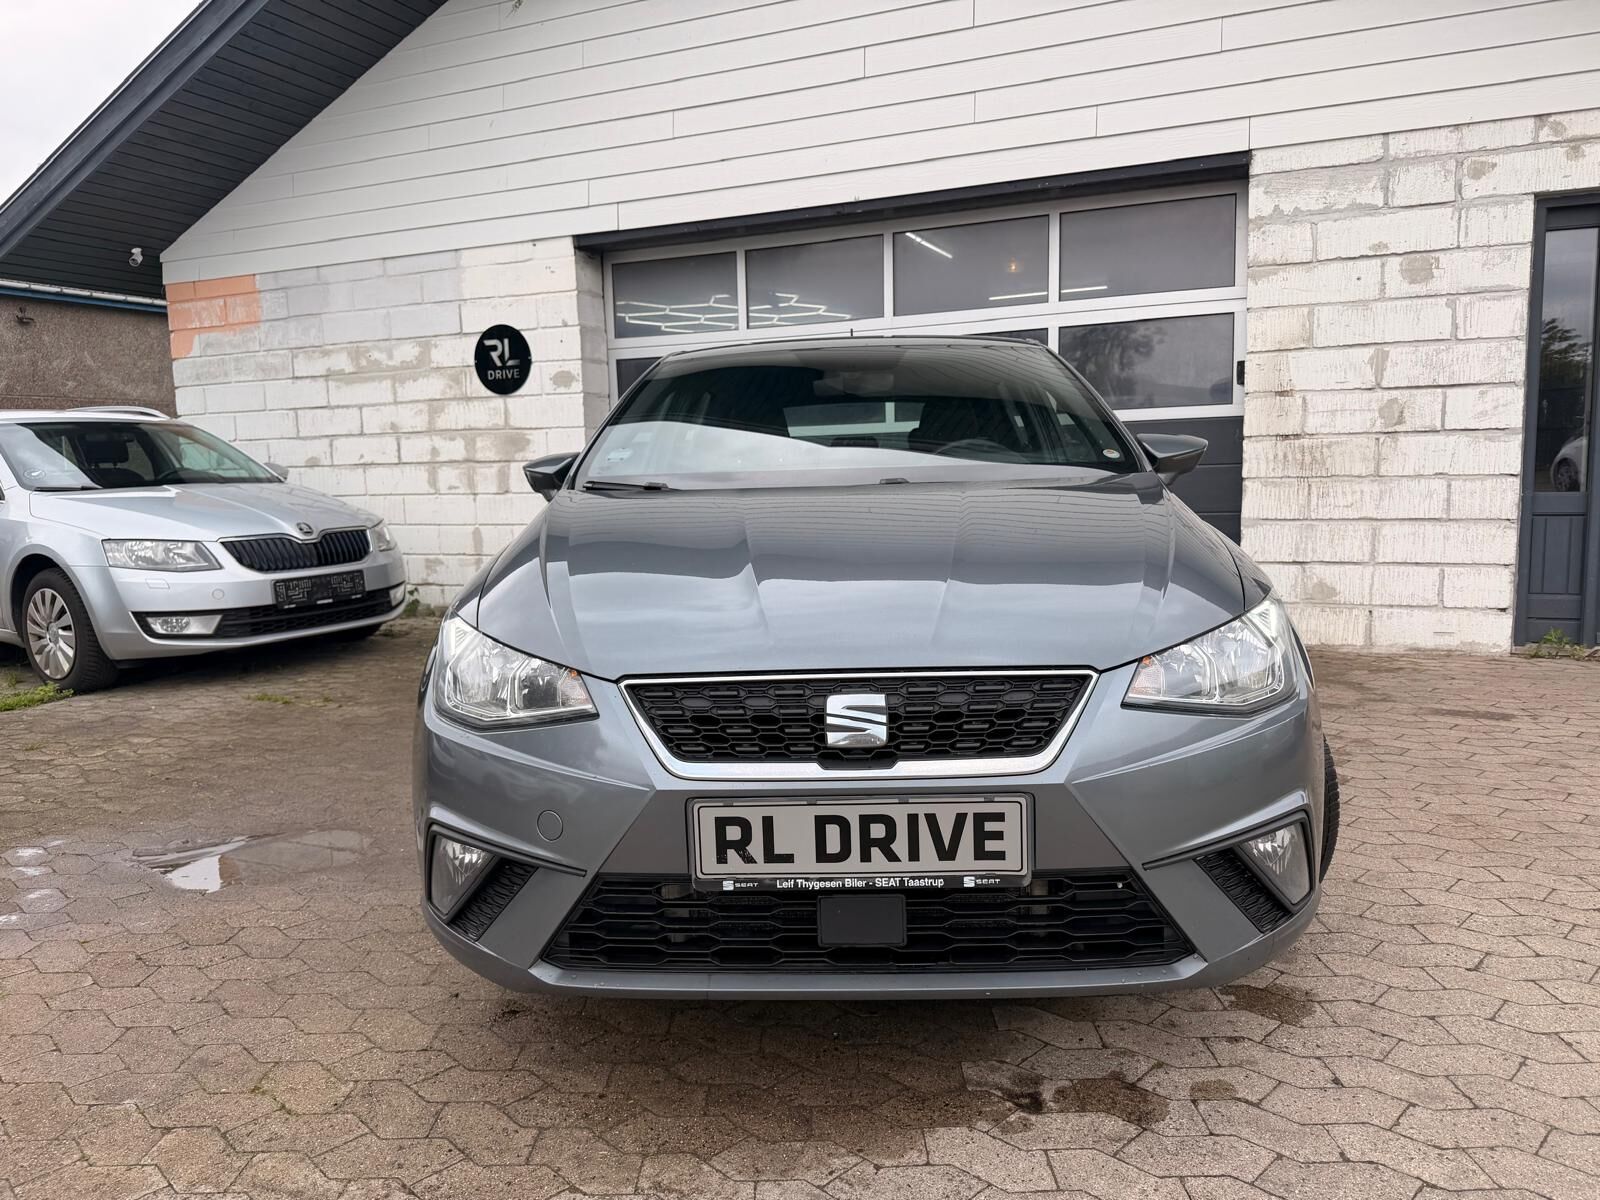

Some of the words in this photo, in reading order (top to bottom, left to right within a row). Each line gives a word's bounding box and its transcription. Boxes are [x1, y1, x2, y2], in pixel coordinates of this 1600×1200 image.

[483, 338, 520, 367] RL
[487, 368, 520, 380] DRIVE
[714, 815, 795, 864] RL
[814, 812, 1006, 864] DRIVE
[776, 879, 794, 888] Leif
[796, 879, 842, 890] Thygesen
[844, 878, 867, 888] Biler
[874, 877, 901, 887] SEAT
[902, 877, 944, 888] Taastrup
